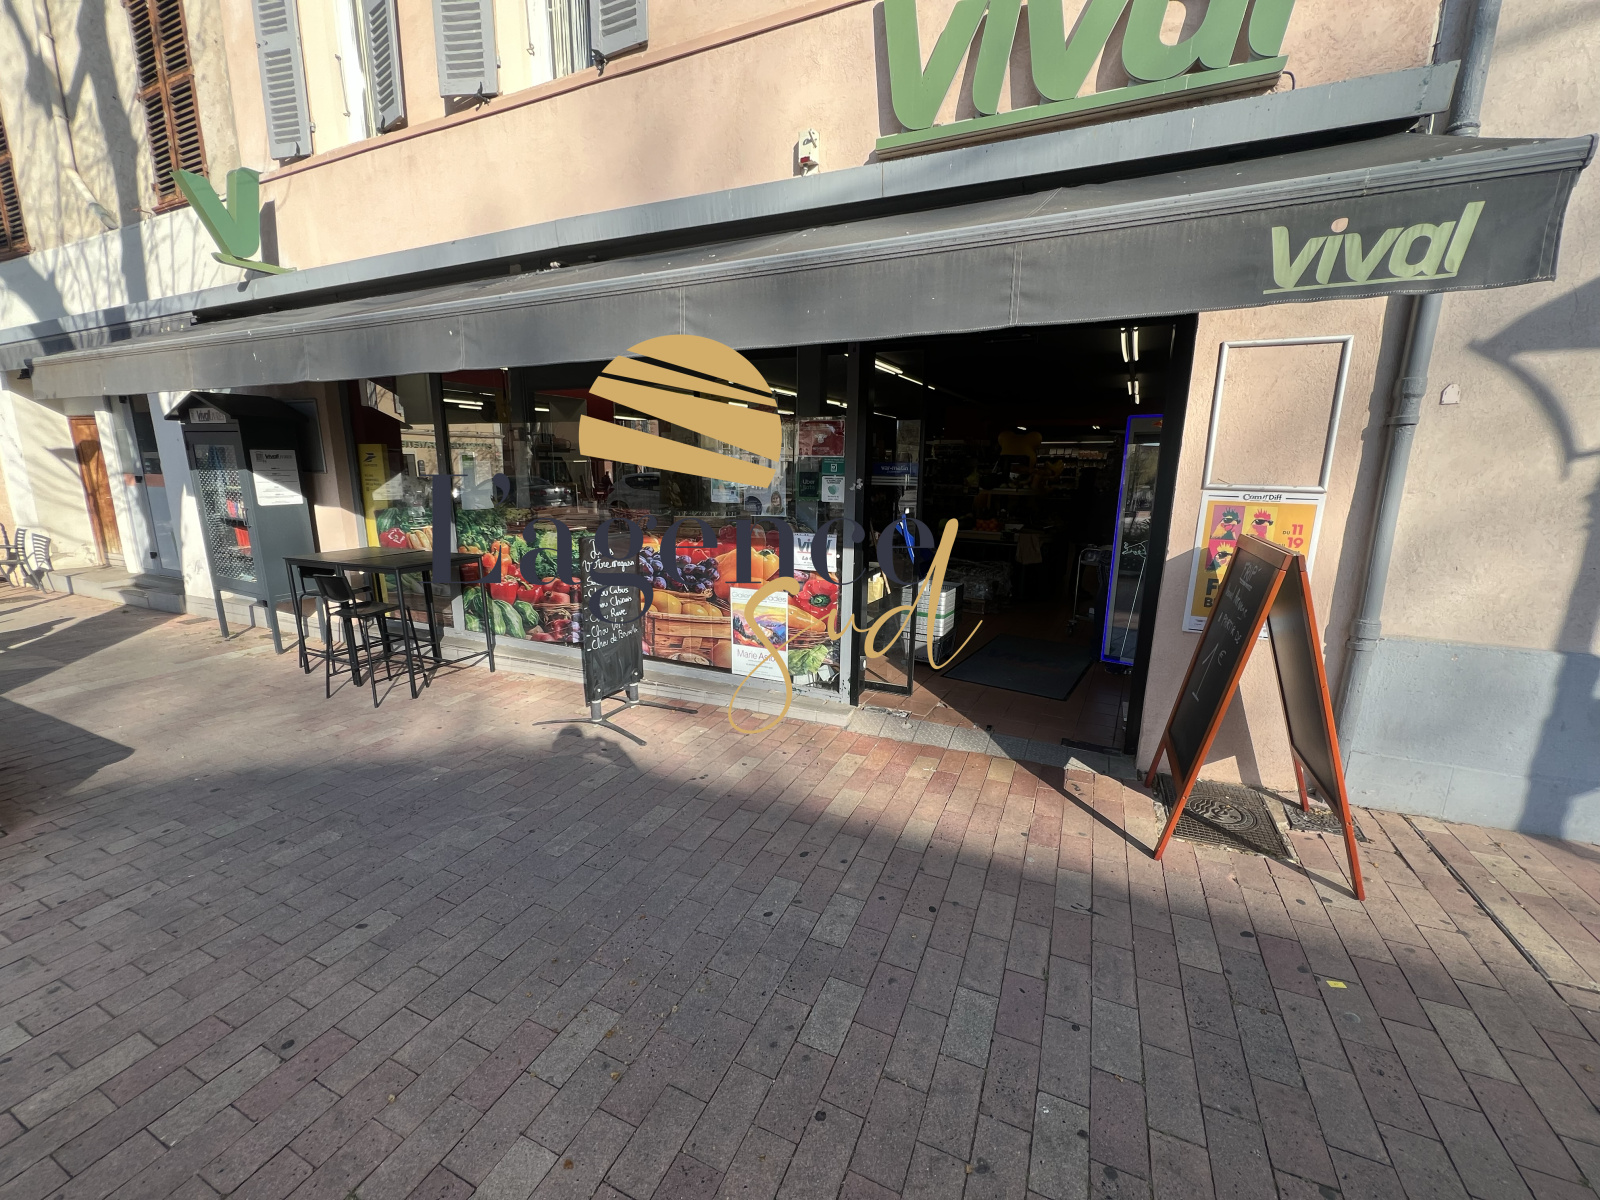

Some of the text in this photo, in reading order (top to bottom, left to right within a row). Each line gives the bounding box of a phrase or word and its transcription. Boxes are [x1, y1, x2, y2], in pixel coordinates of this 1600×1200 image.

[1291, 523, 1304, 536] 11
[1287, 536, 1304, 549] 19
[737, 648, 758, 660] Marie
